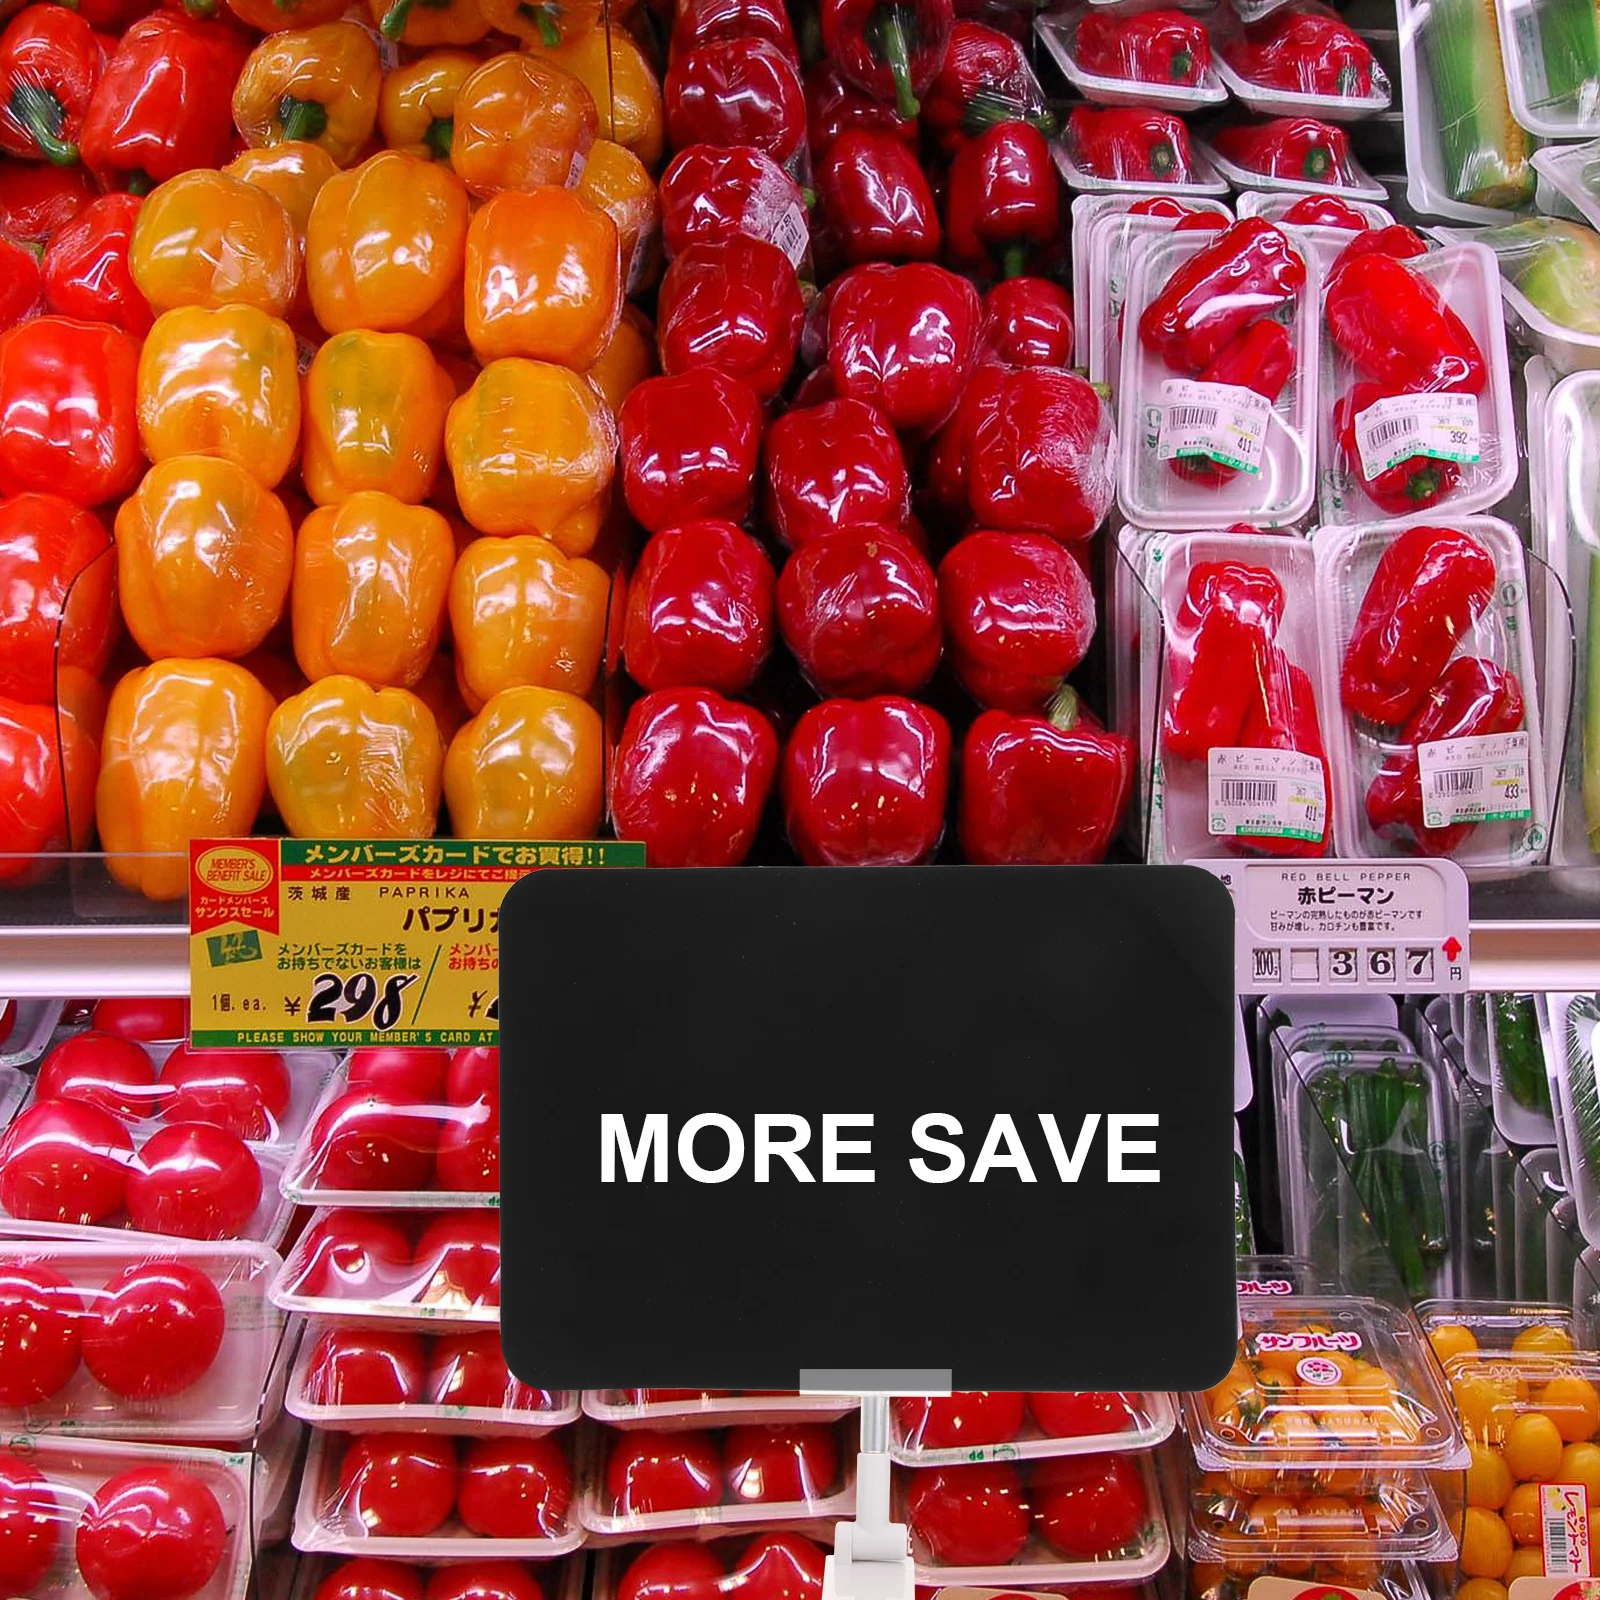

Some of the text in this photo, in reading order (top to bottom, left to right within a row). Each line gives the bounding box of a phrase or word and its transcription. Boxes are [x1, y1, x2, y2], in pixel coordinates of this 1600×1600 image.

[1450, 431, 1468, 445] 392
[1237, 437, 1252, 458] 411
[1504, 784, 1519, 799] 433
[1305, 805, 1317, 821] 411
[1282, 873, 1411, 881] RED BELL PEPPER
[378, 886, 470, 899] PAPRIKA
[1298, 886, 1394, 905] 赤ピーマン
[195, 906, 274, 918] サンクスセール
[278, 943, 407, 956] メンバーズカードを
[1450, 967, 1462, 981] 円
[237, 1032, 284, 1043] PLEASE
[293, 1032, 323, 1043] SHOW
[332, 1032, 362, 1043] YOUR
[440, 1032, 470, 1043] CARD
[478, 1032, 493, 1043] AT
[600, 1112, 1161, 1184] MORE SAVE
[1260, 1335, 1359, 1349] サンフルーツ
[1564, 1492, 1582, 1573] レモントマト
